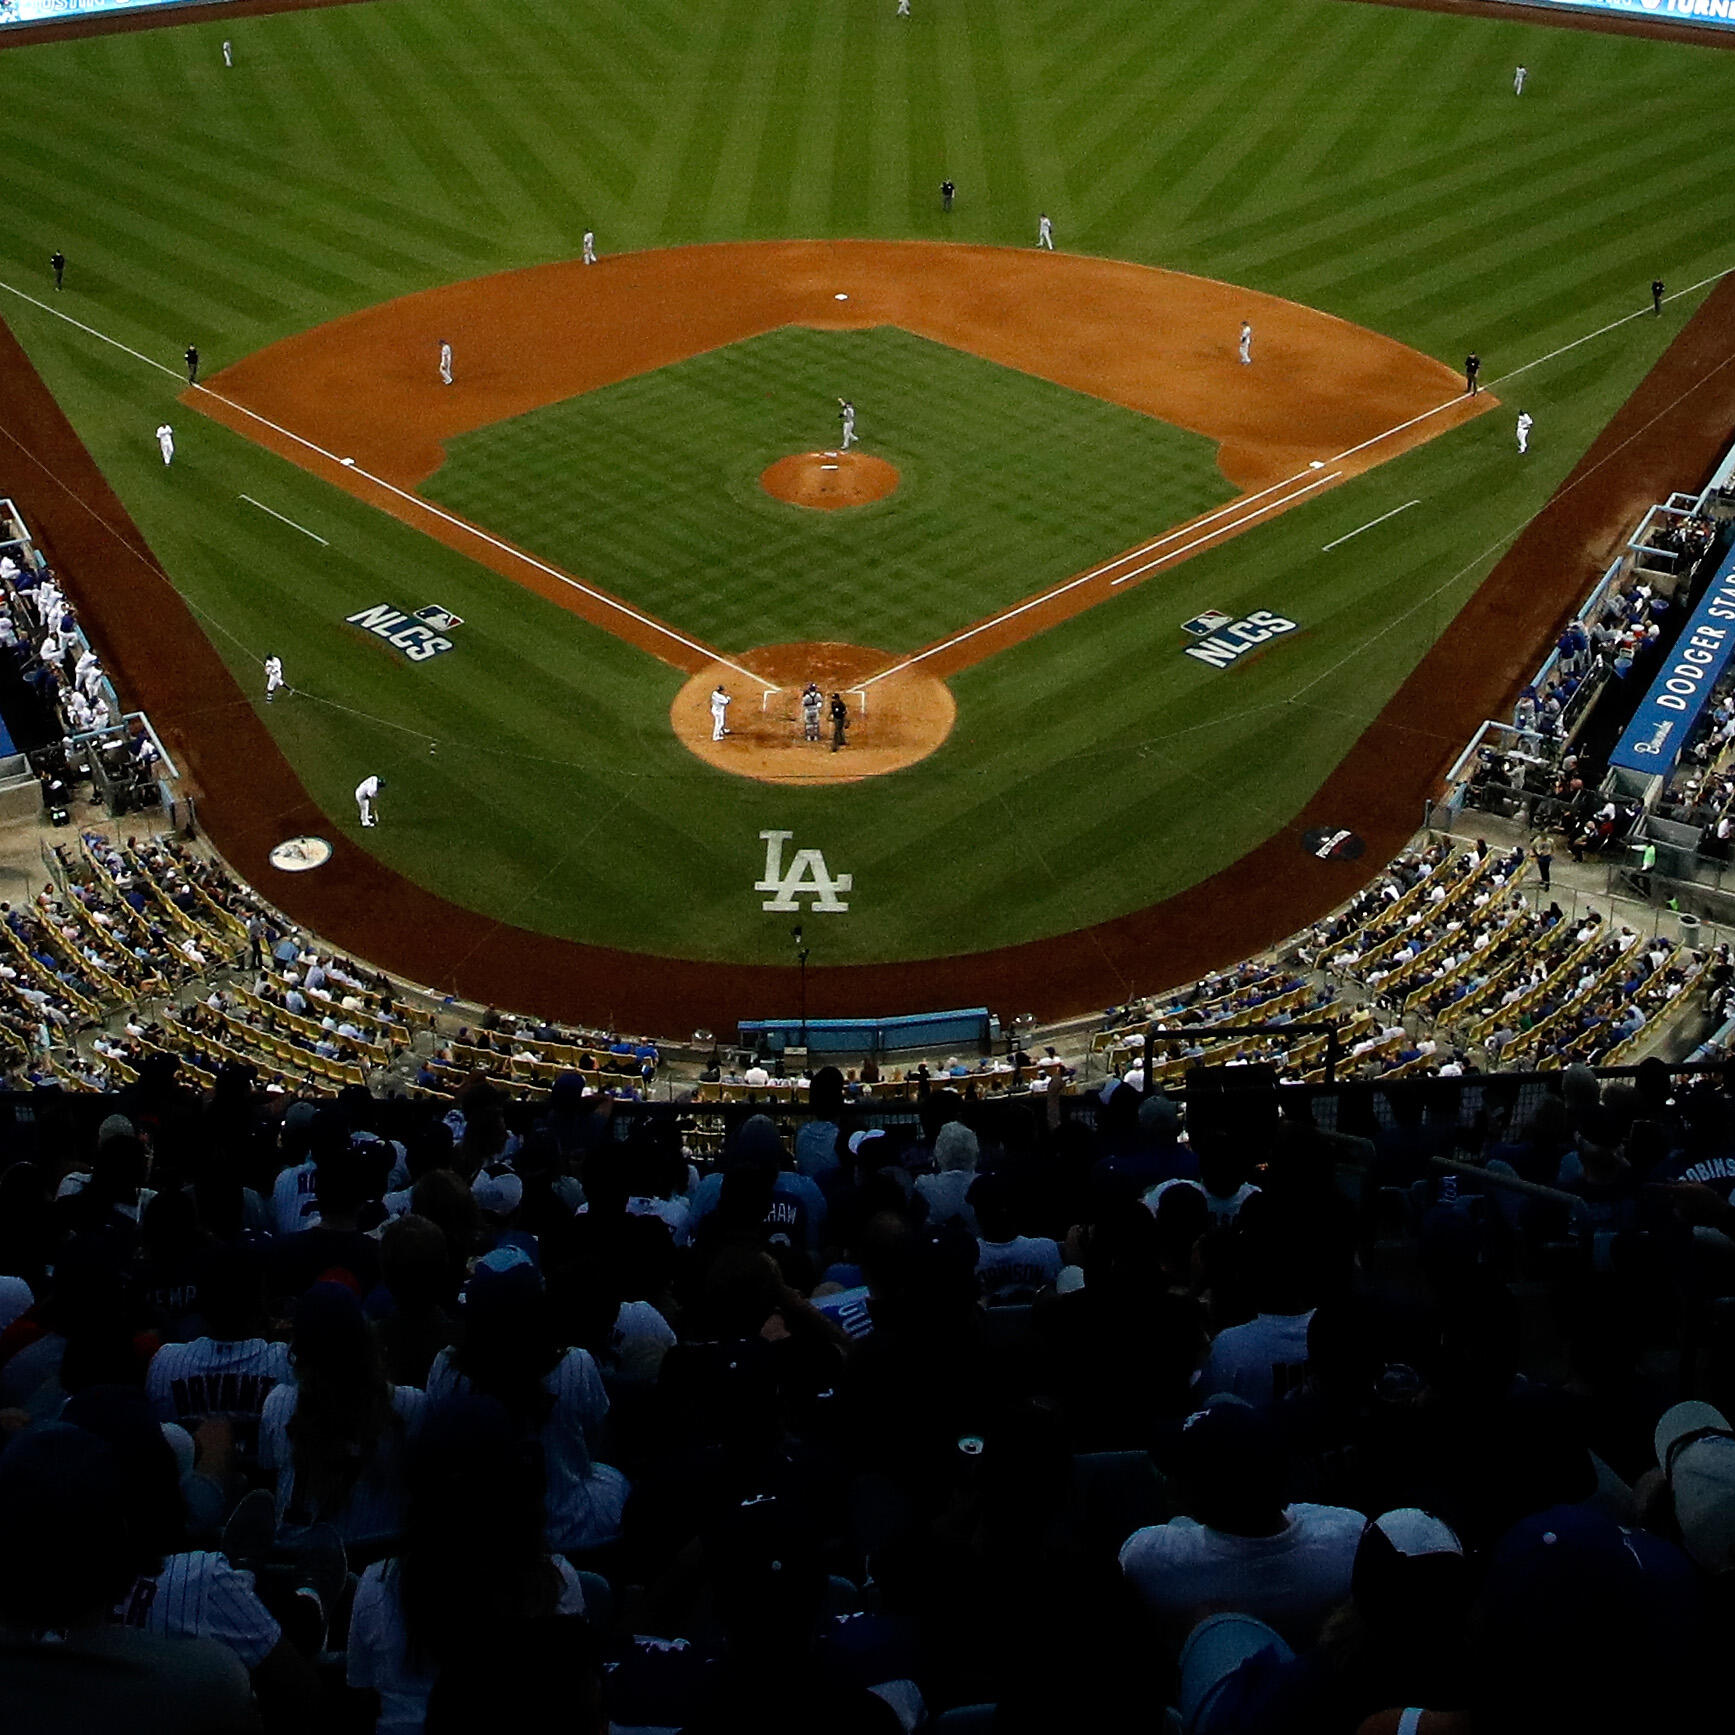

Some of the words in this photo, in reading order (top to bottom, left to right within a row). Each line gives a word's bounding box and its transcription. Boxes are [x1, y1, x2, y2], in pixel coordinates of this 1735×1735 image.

[345, 602, 454, 662] NLCS
[1184, 609, 1296, 669] NLCS
[1656, 625, 1727, 712] DODGER
[754, 830, 852, 912] LA
